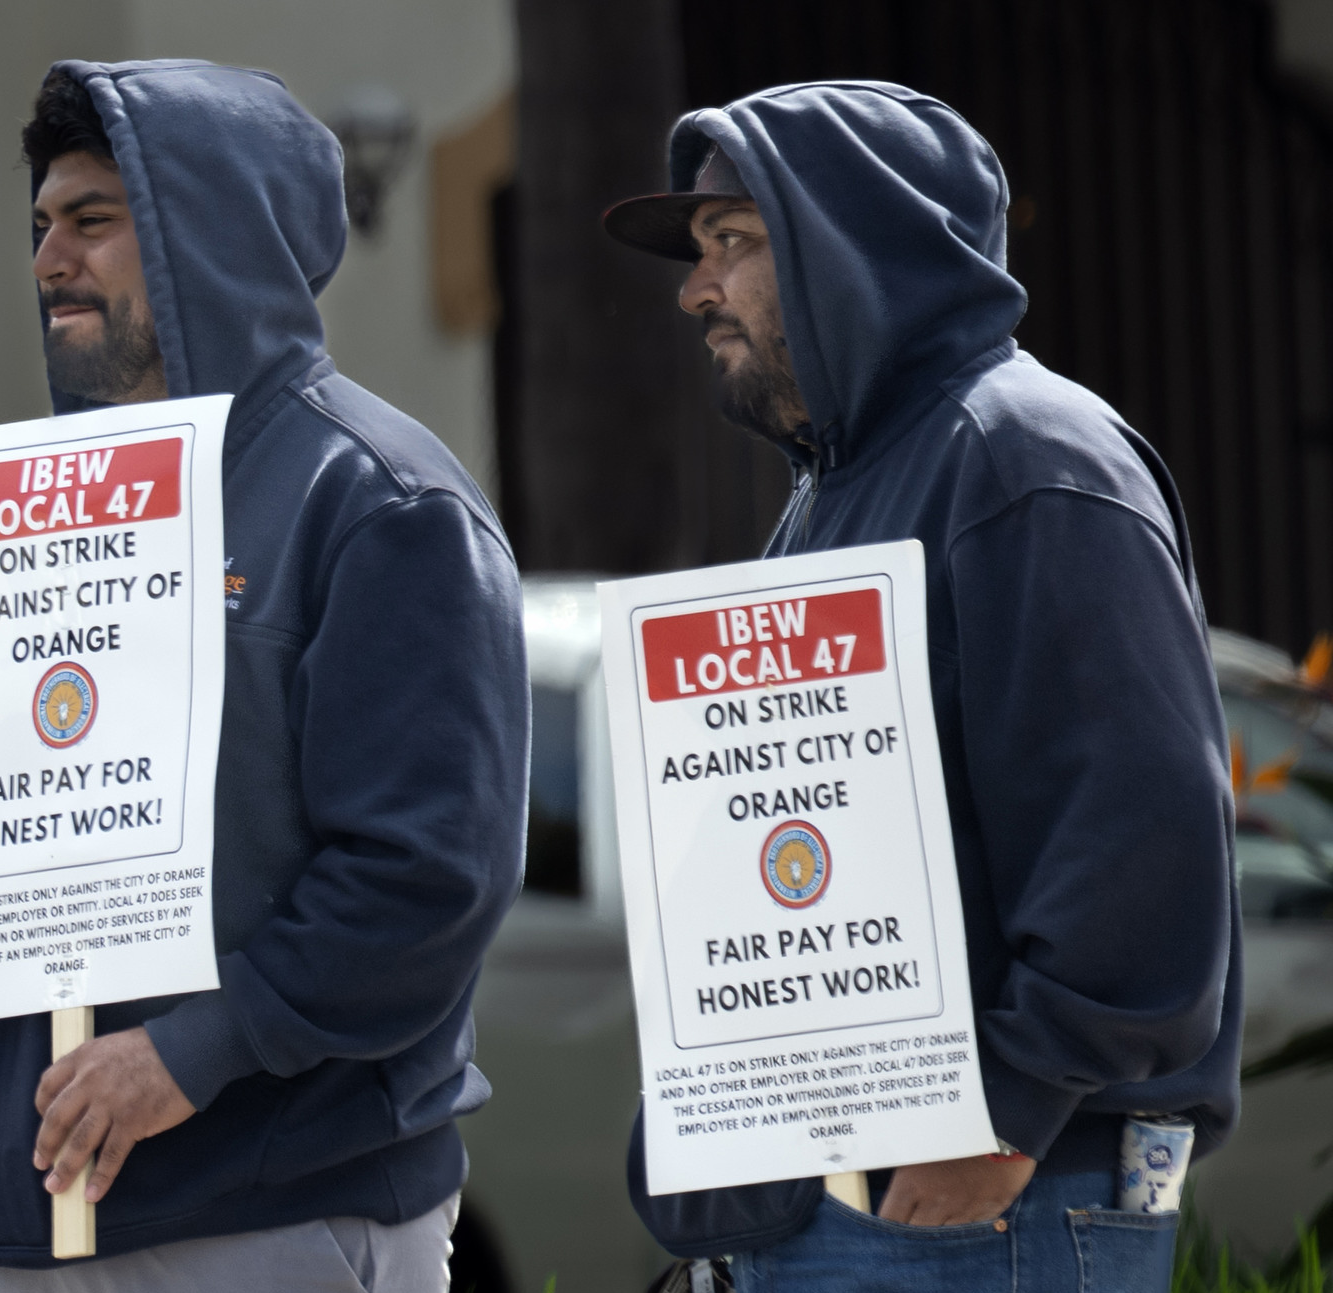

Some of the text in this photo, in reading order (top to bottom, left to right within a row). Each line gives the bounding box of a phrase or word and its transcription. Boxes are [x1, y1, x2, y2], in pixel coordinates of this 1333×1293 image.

[20, 449, 114, 492] IBEW
[105, 480, 154, 518] 47
[45, 531, 135, 567] STRIKE
[76, 576, 137, 607] CITY
[146, 570, 181, 599] OF
[12, 623, 120, 663] ORANGE
[716, 600, 806, 646] IBEW
[675, 634, 856, 693] LOCAL 47
[704, 685, 847, 729] ON STRIKE
[41, 763, 92, 795] PAY
[102, 756, 151, 786] FOR
[661, 726, 896, 783] AGAINST CITY OF
[70, 798, 161, 835] WORK!
[728, 780, 848, 821] ORANGE
[10, 929, 24, 941] OR
[25, 919, 94, 939] WITHHOLDING
[96, 917, 108, 929] OF
[111, 910, 154, 927] SERVICES
[157, 908, 169, 920] BY
[172, 905, 192, 918] ANY
[706, 916, 902, 965] FAIR PAY FOR
[697, 960, 919, 1014] HONEST WORK!
[656, 1031, 968, 1081] LOCAL 47 IS ON STRIKE ONLY AGAINST THE CITY OF ORANGE
